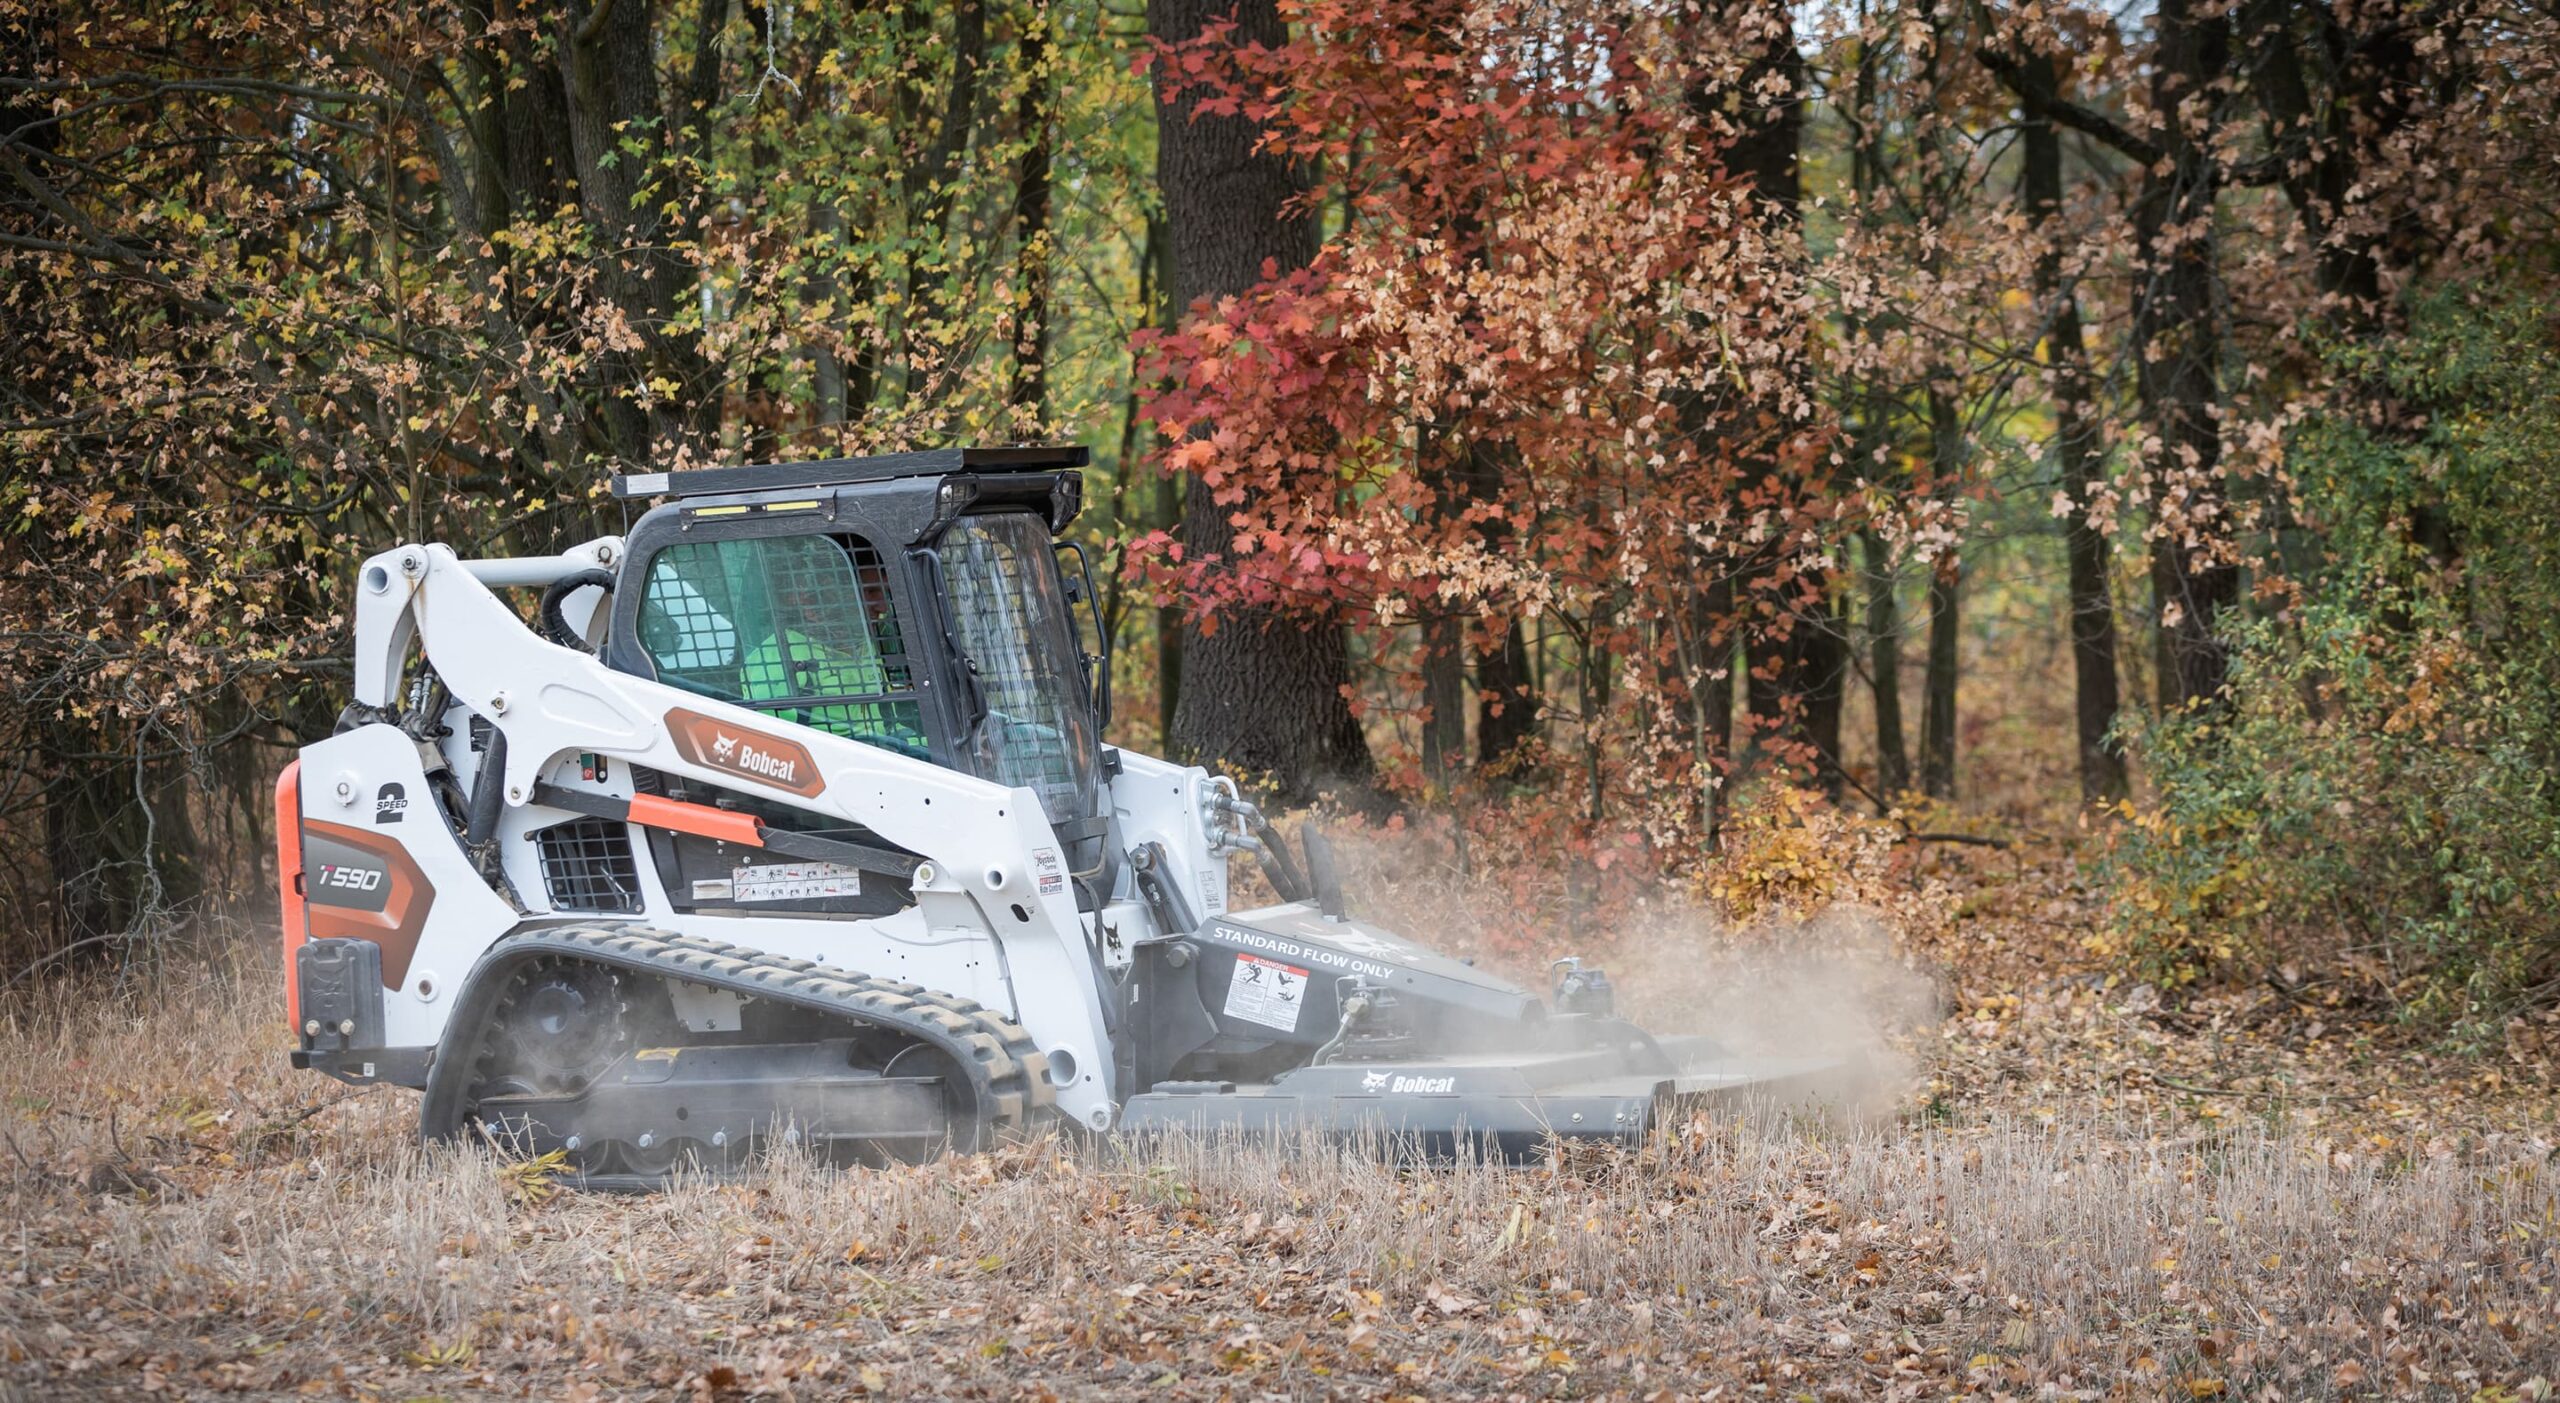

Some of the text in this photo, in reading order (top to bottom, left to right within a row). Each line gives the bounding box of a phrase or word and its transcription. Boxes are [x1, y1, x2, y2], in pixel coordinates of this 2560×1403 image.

[739, 745, 795, 781] Bobcat
[375, 782, 408, 824] 2 SPEED
[319, 864, 382, 891] T590
[1213, 927, 1393, 979] STANDARD FLOW ONLY
[1260, 960, 1289, 972] DANGER
[1391, 1076, 1455, 1093] Bobcat
